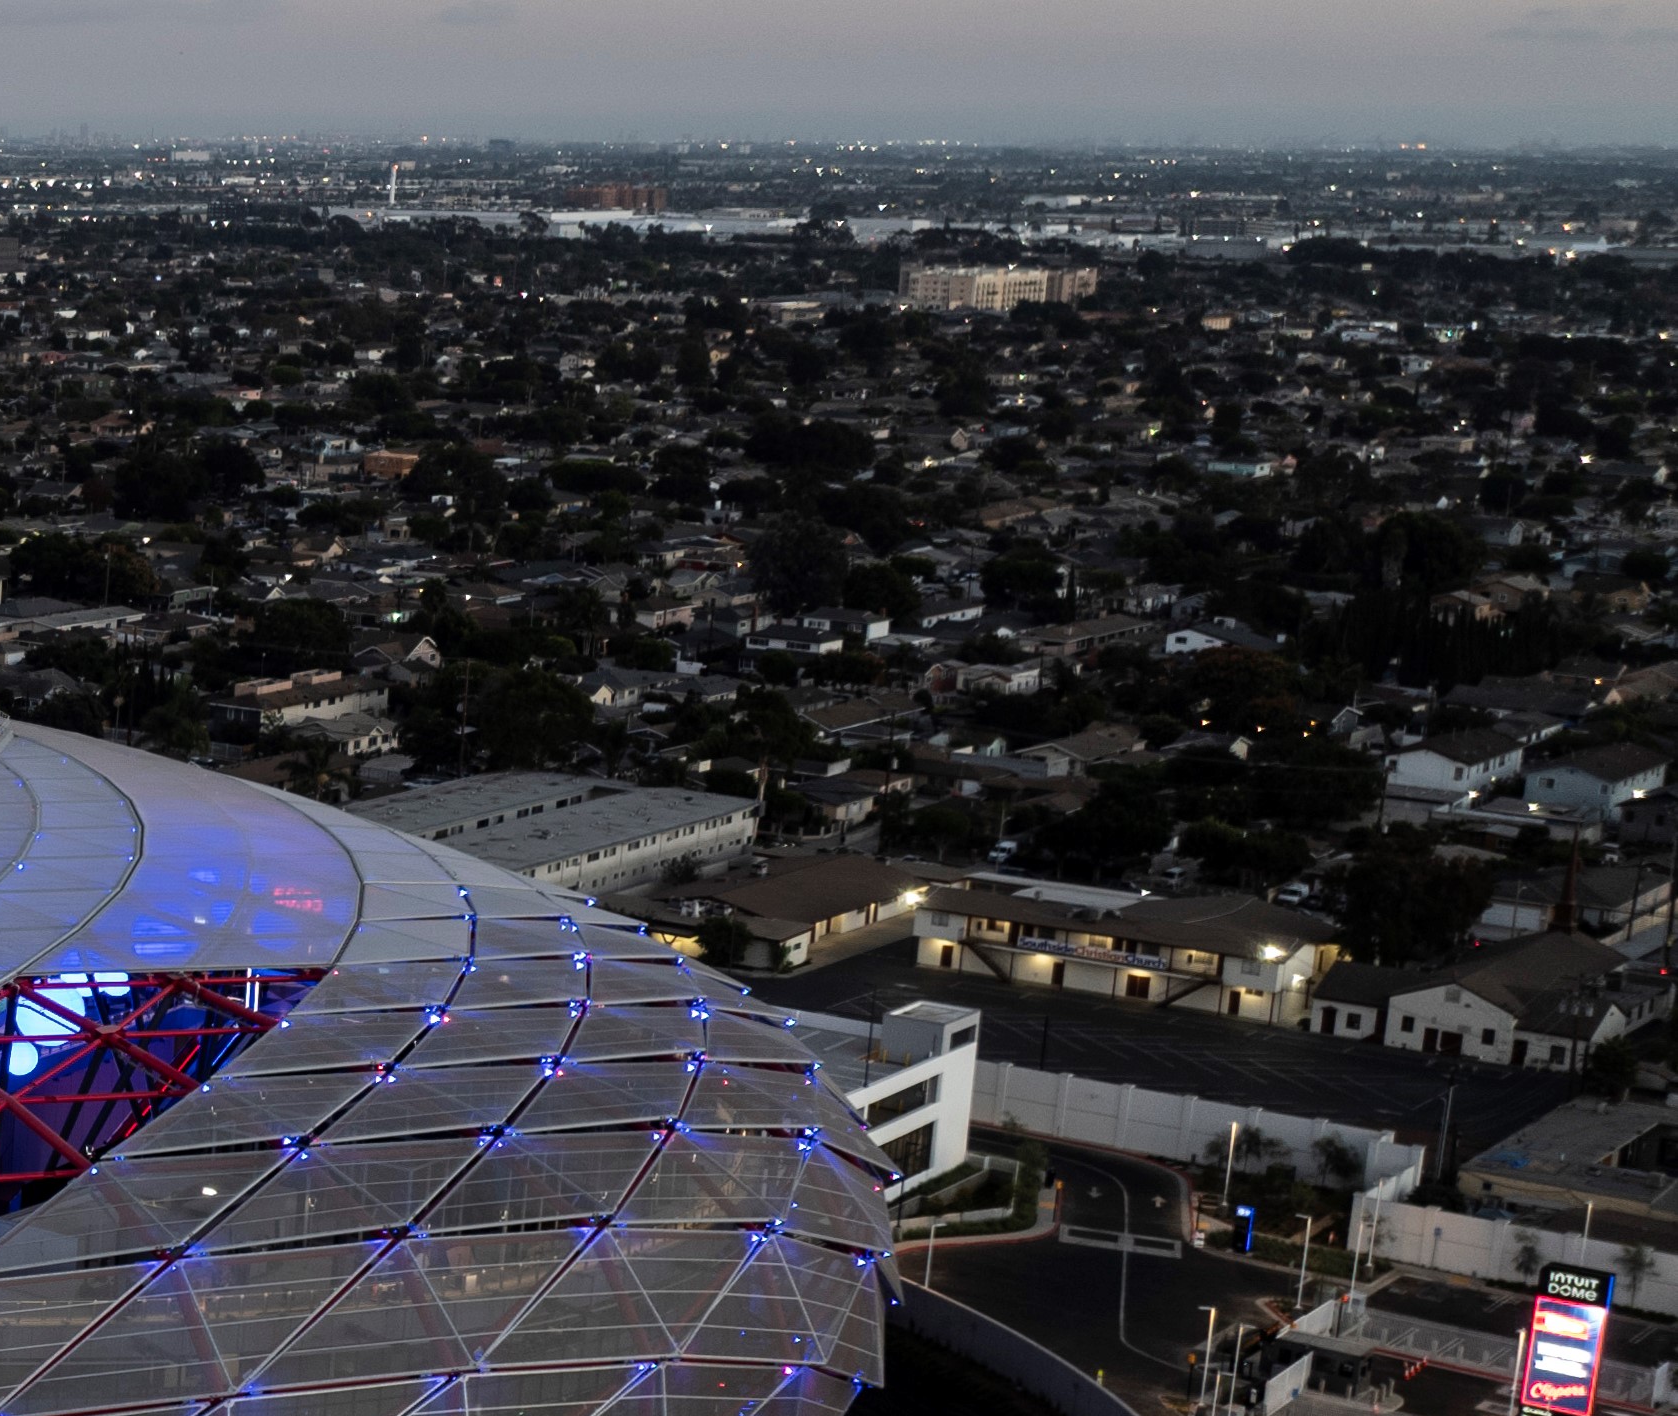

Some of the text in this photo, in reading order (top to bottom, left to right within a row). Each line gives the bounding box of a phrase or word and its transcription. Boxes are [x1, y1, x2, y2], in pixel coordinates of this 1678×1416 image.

[1074, 945, 1125, 962] Christian
[1124, 953, 1167, 969] Church
[1550, 1271, 1600, 1290] INTUIT
[1548, 1282, 1597, 1302] DOME
